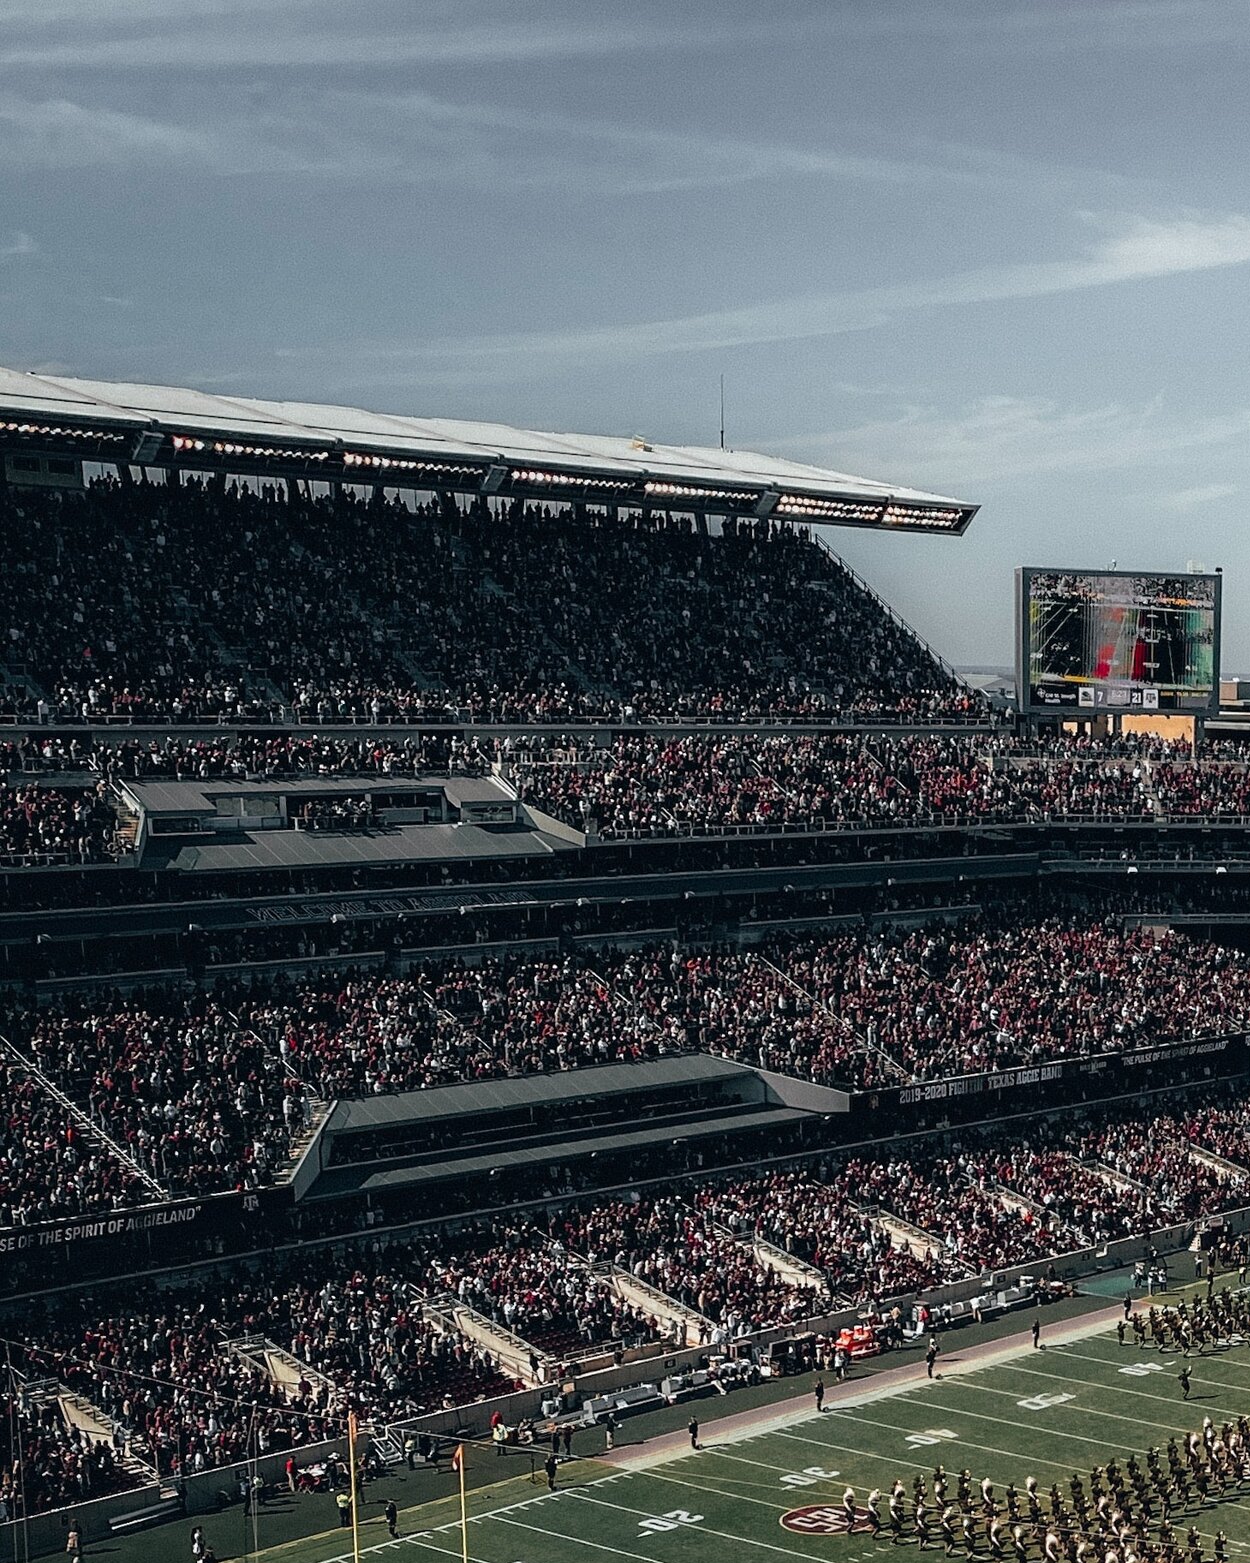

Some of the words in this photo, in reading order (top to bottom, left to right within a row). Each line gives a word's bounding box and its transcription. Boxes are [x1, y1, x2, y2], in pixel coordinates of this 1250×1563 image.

[1132, 692, 1141, 703] 21
[900, 1084, 947, 1103] 2019-2020
[988, 1071, 1015, 1089] TEXAS
[1017, 1068, 1039, 1084] AGGIE
[18, 1234, 35, 1248] OF
[38, 1229, 62, 1245] THE
[65, 1221, 107, 1240] SPIRIT
[108, 1218, 124, 1234] OF
[779, 1466, 840, 1486] 30
[637, 1509, 704, 1532] 20
